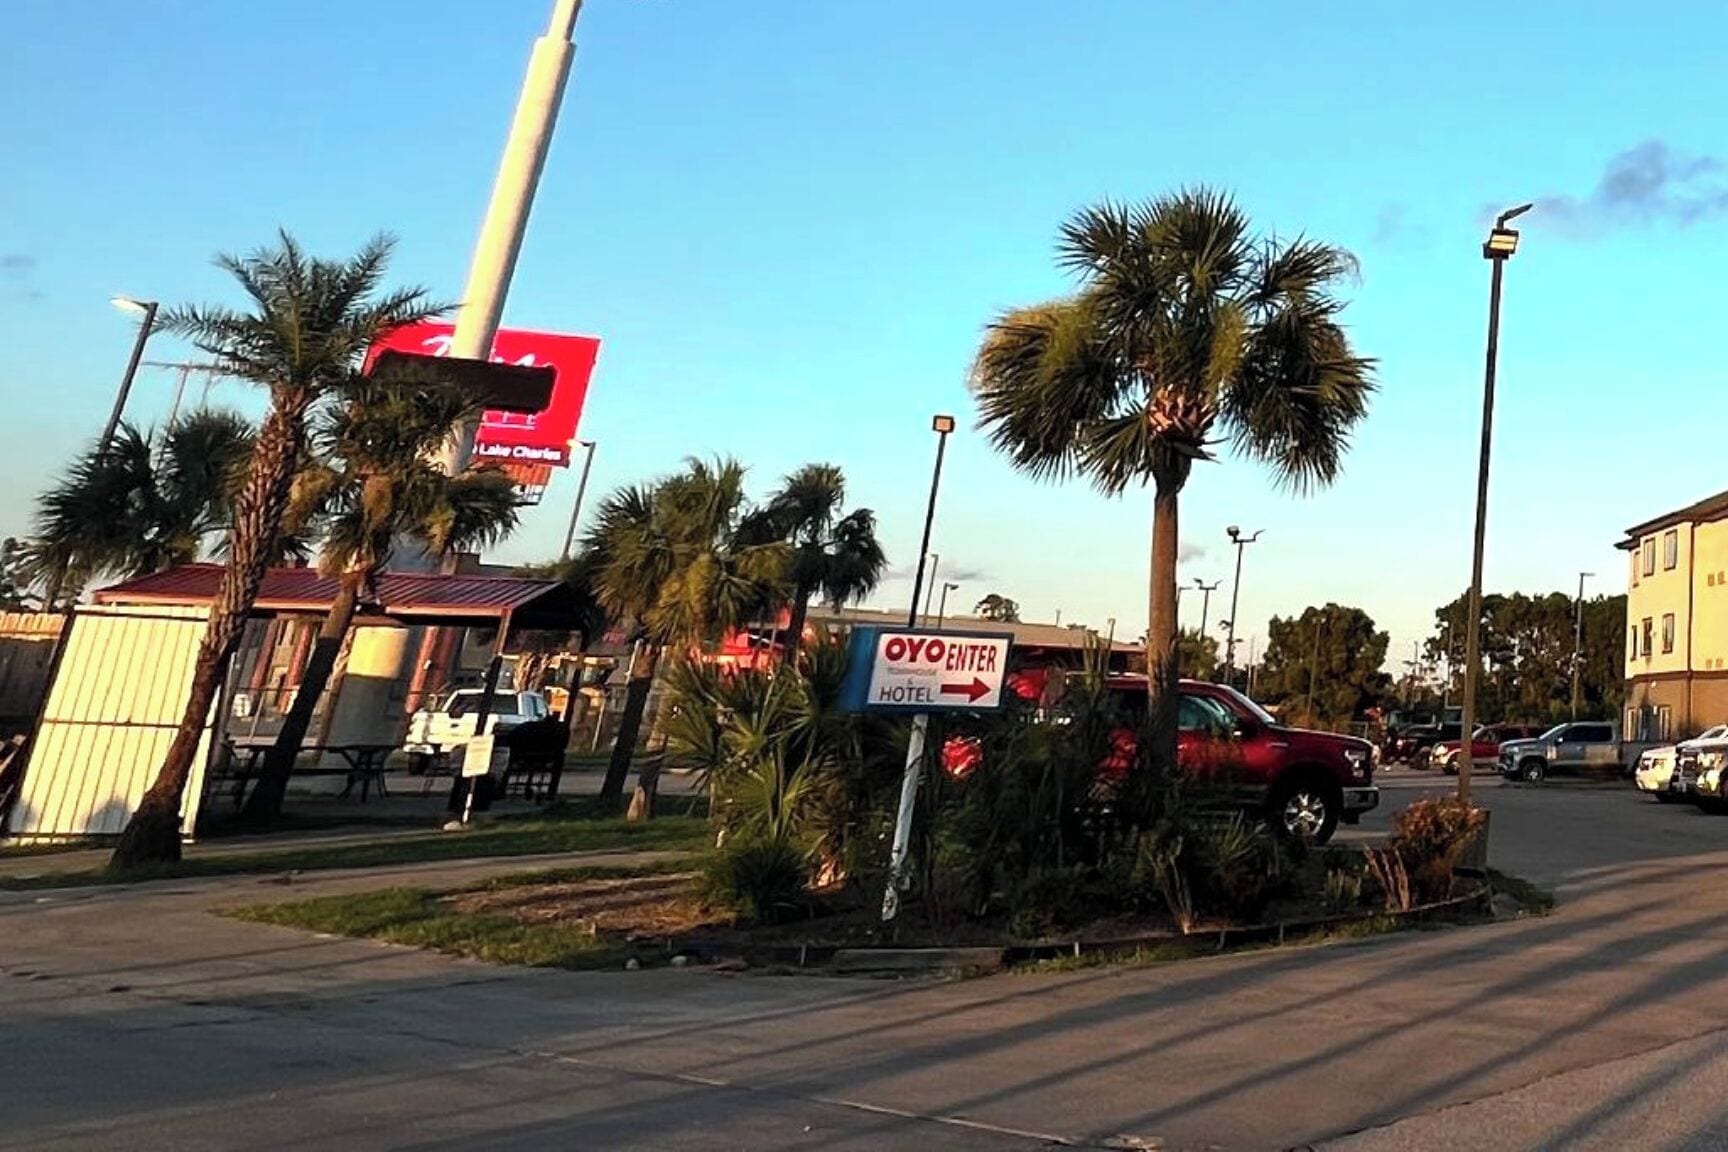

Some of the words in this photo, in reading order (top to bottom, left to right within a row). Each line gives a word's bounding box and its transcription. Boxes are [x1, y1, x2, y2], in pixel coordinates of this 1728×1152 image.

[885, 637, 946, 663] OYO
[945, 643, 997, 673] ENTER
[879, 685, 935, 703] HOTEL
